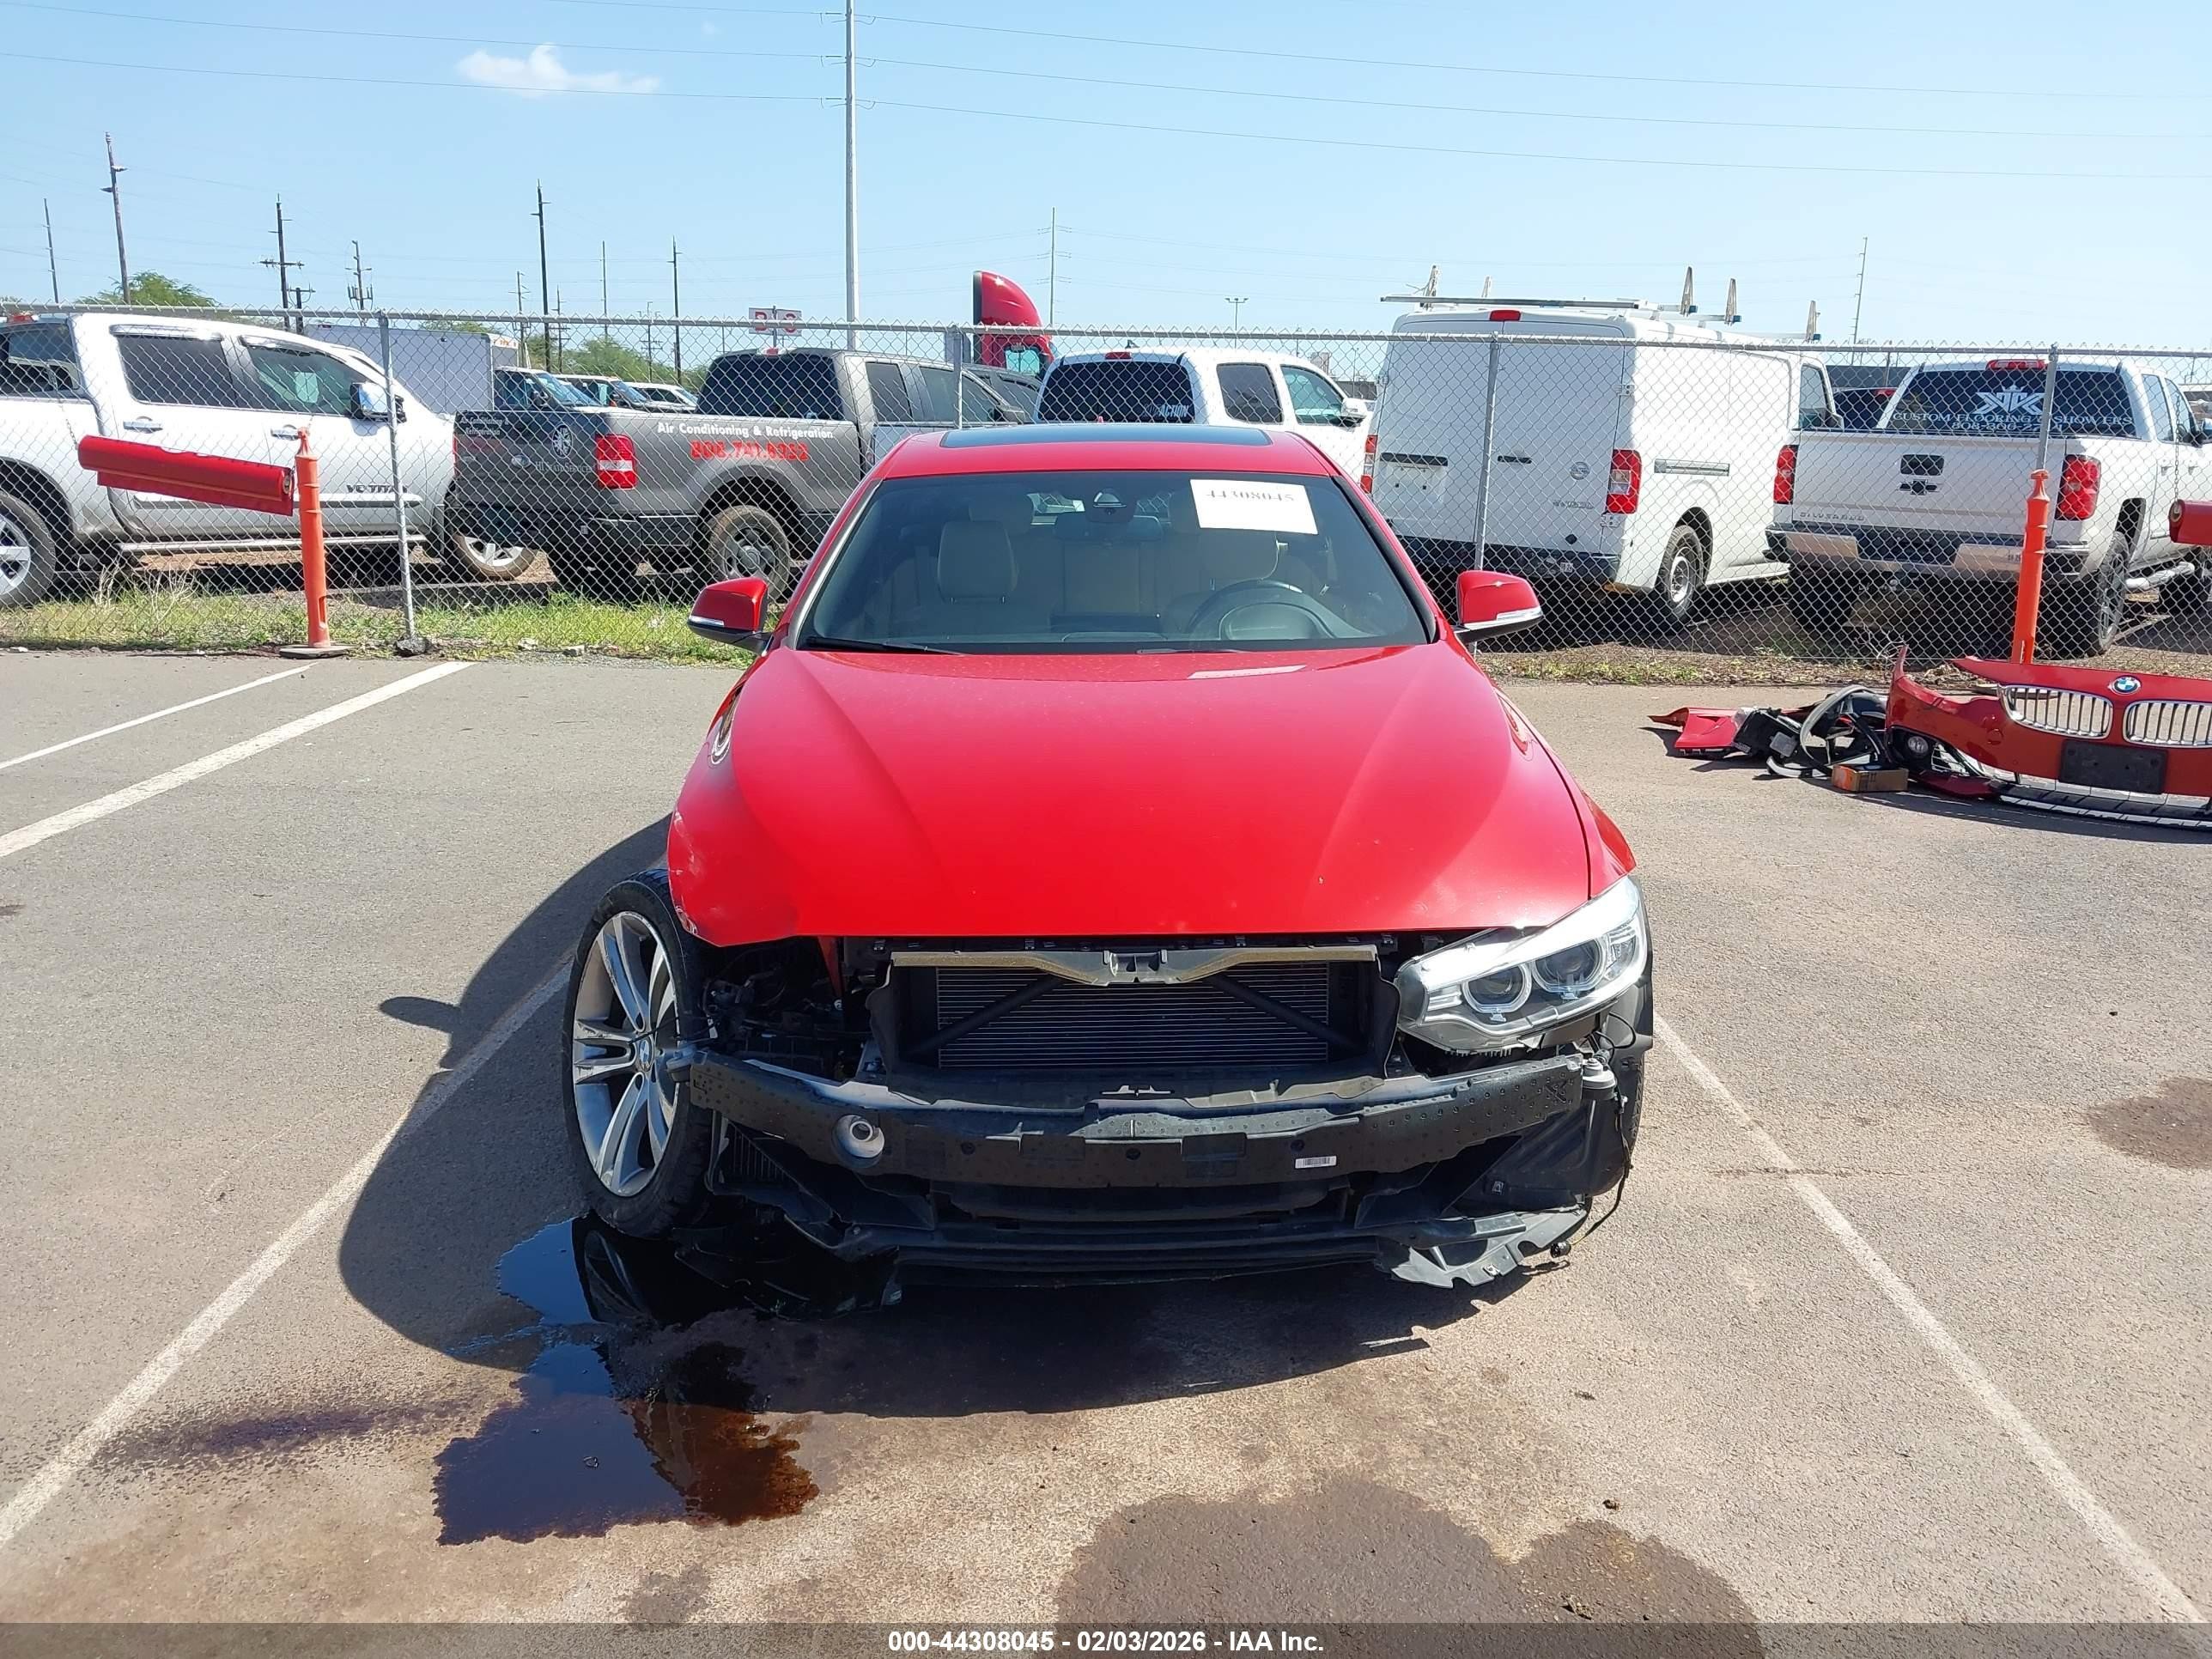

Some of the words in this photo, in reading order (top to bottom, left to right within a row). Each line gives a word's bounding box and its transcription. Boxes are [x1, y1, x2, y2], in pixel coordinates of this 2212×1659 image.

[1893, 412, 1950, 422] CUSTOM
[1957, 414, 2031, 423] FLOORING
[2053, 416, 2133, 424] SHOWERS
[657, 422, 673, 434] Air
[679, 423, 749, 438] Conditioning
[753, 425, 763, 436] &
[765, 425, 834, 440] Refrigeration
[1206, 489, 1296, 501] 44308045
